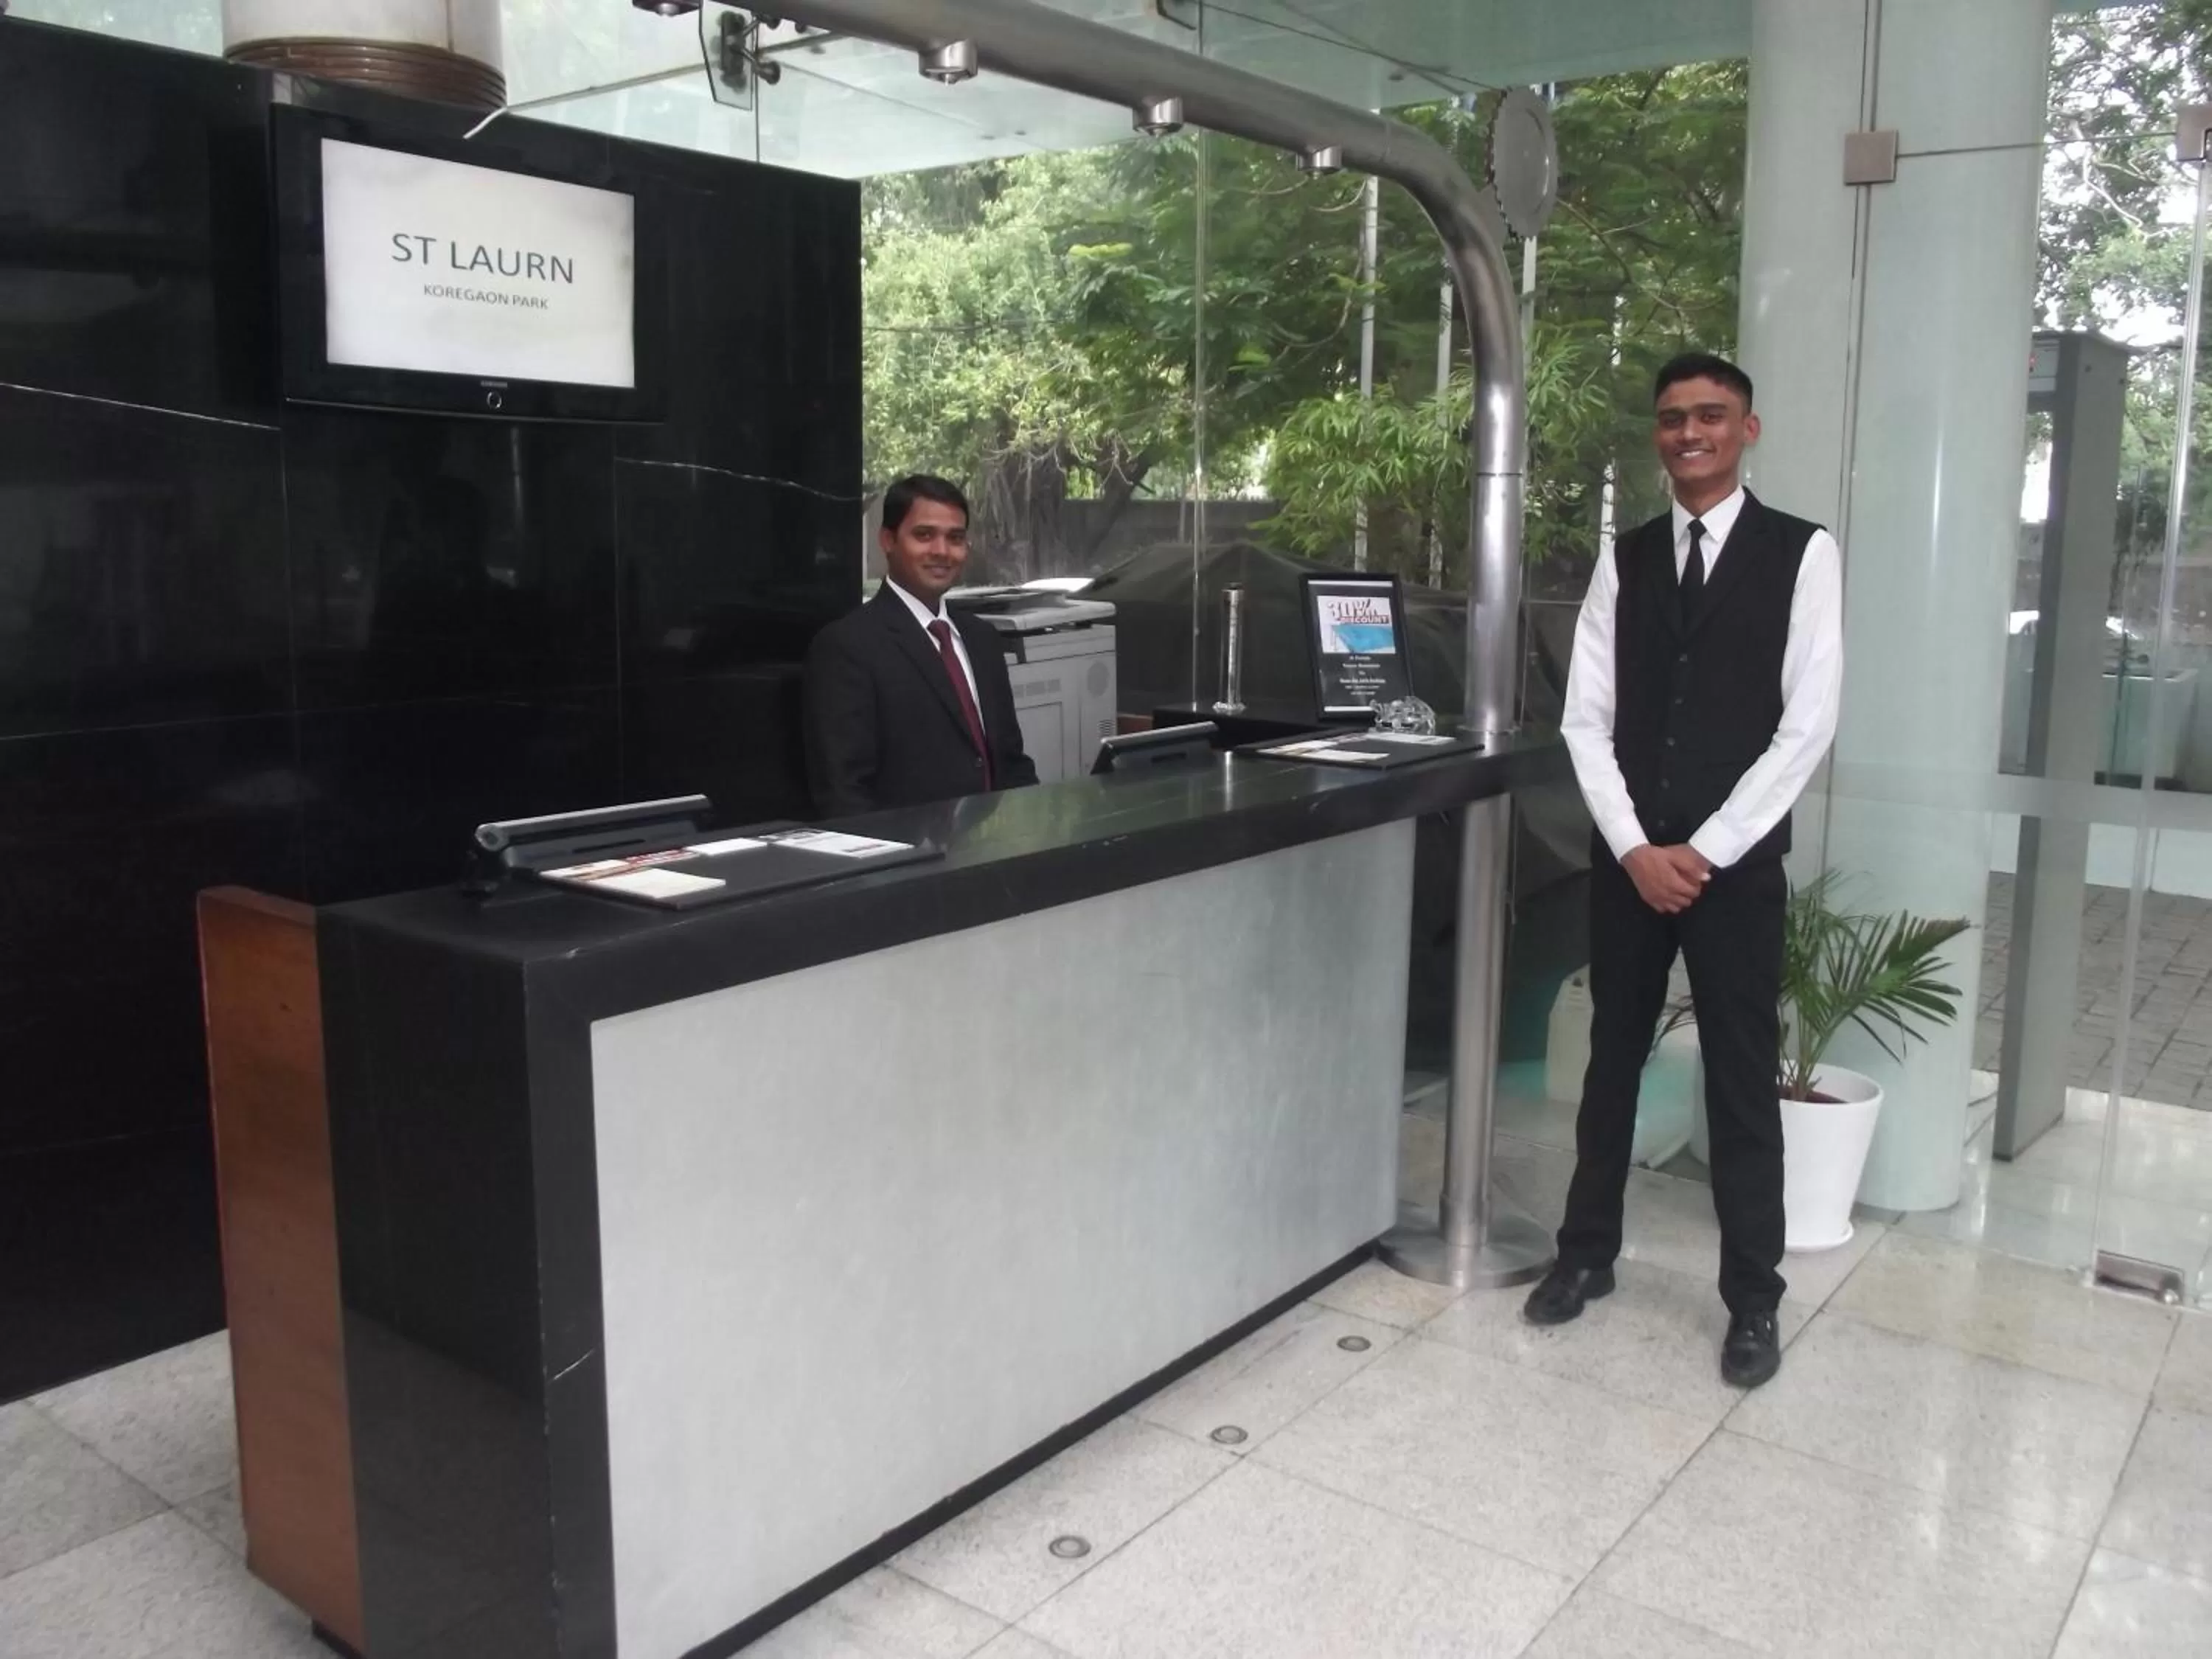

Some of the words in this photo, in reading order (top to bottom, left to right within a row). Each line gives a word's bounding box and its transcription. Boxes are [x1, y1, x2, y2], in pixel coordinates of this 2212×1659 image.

[392, 233, 437, 265] ST
[450, 240, 574, 285] LAURN
[423, 284, 509, 305] KOREGAON
[512, 294, 548, 310] PARK
